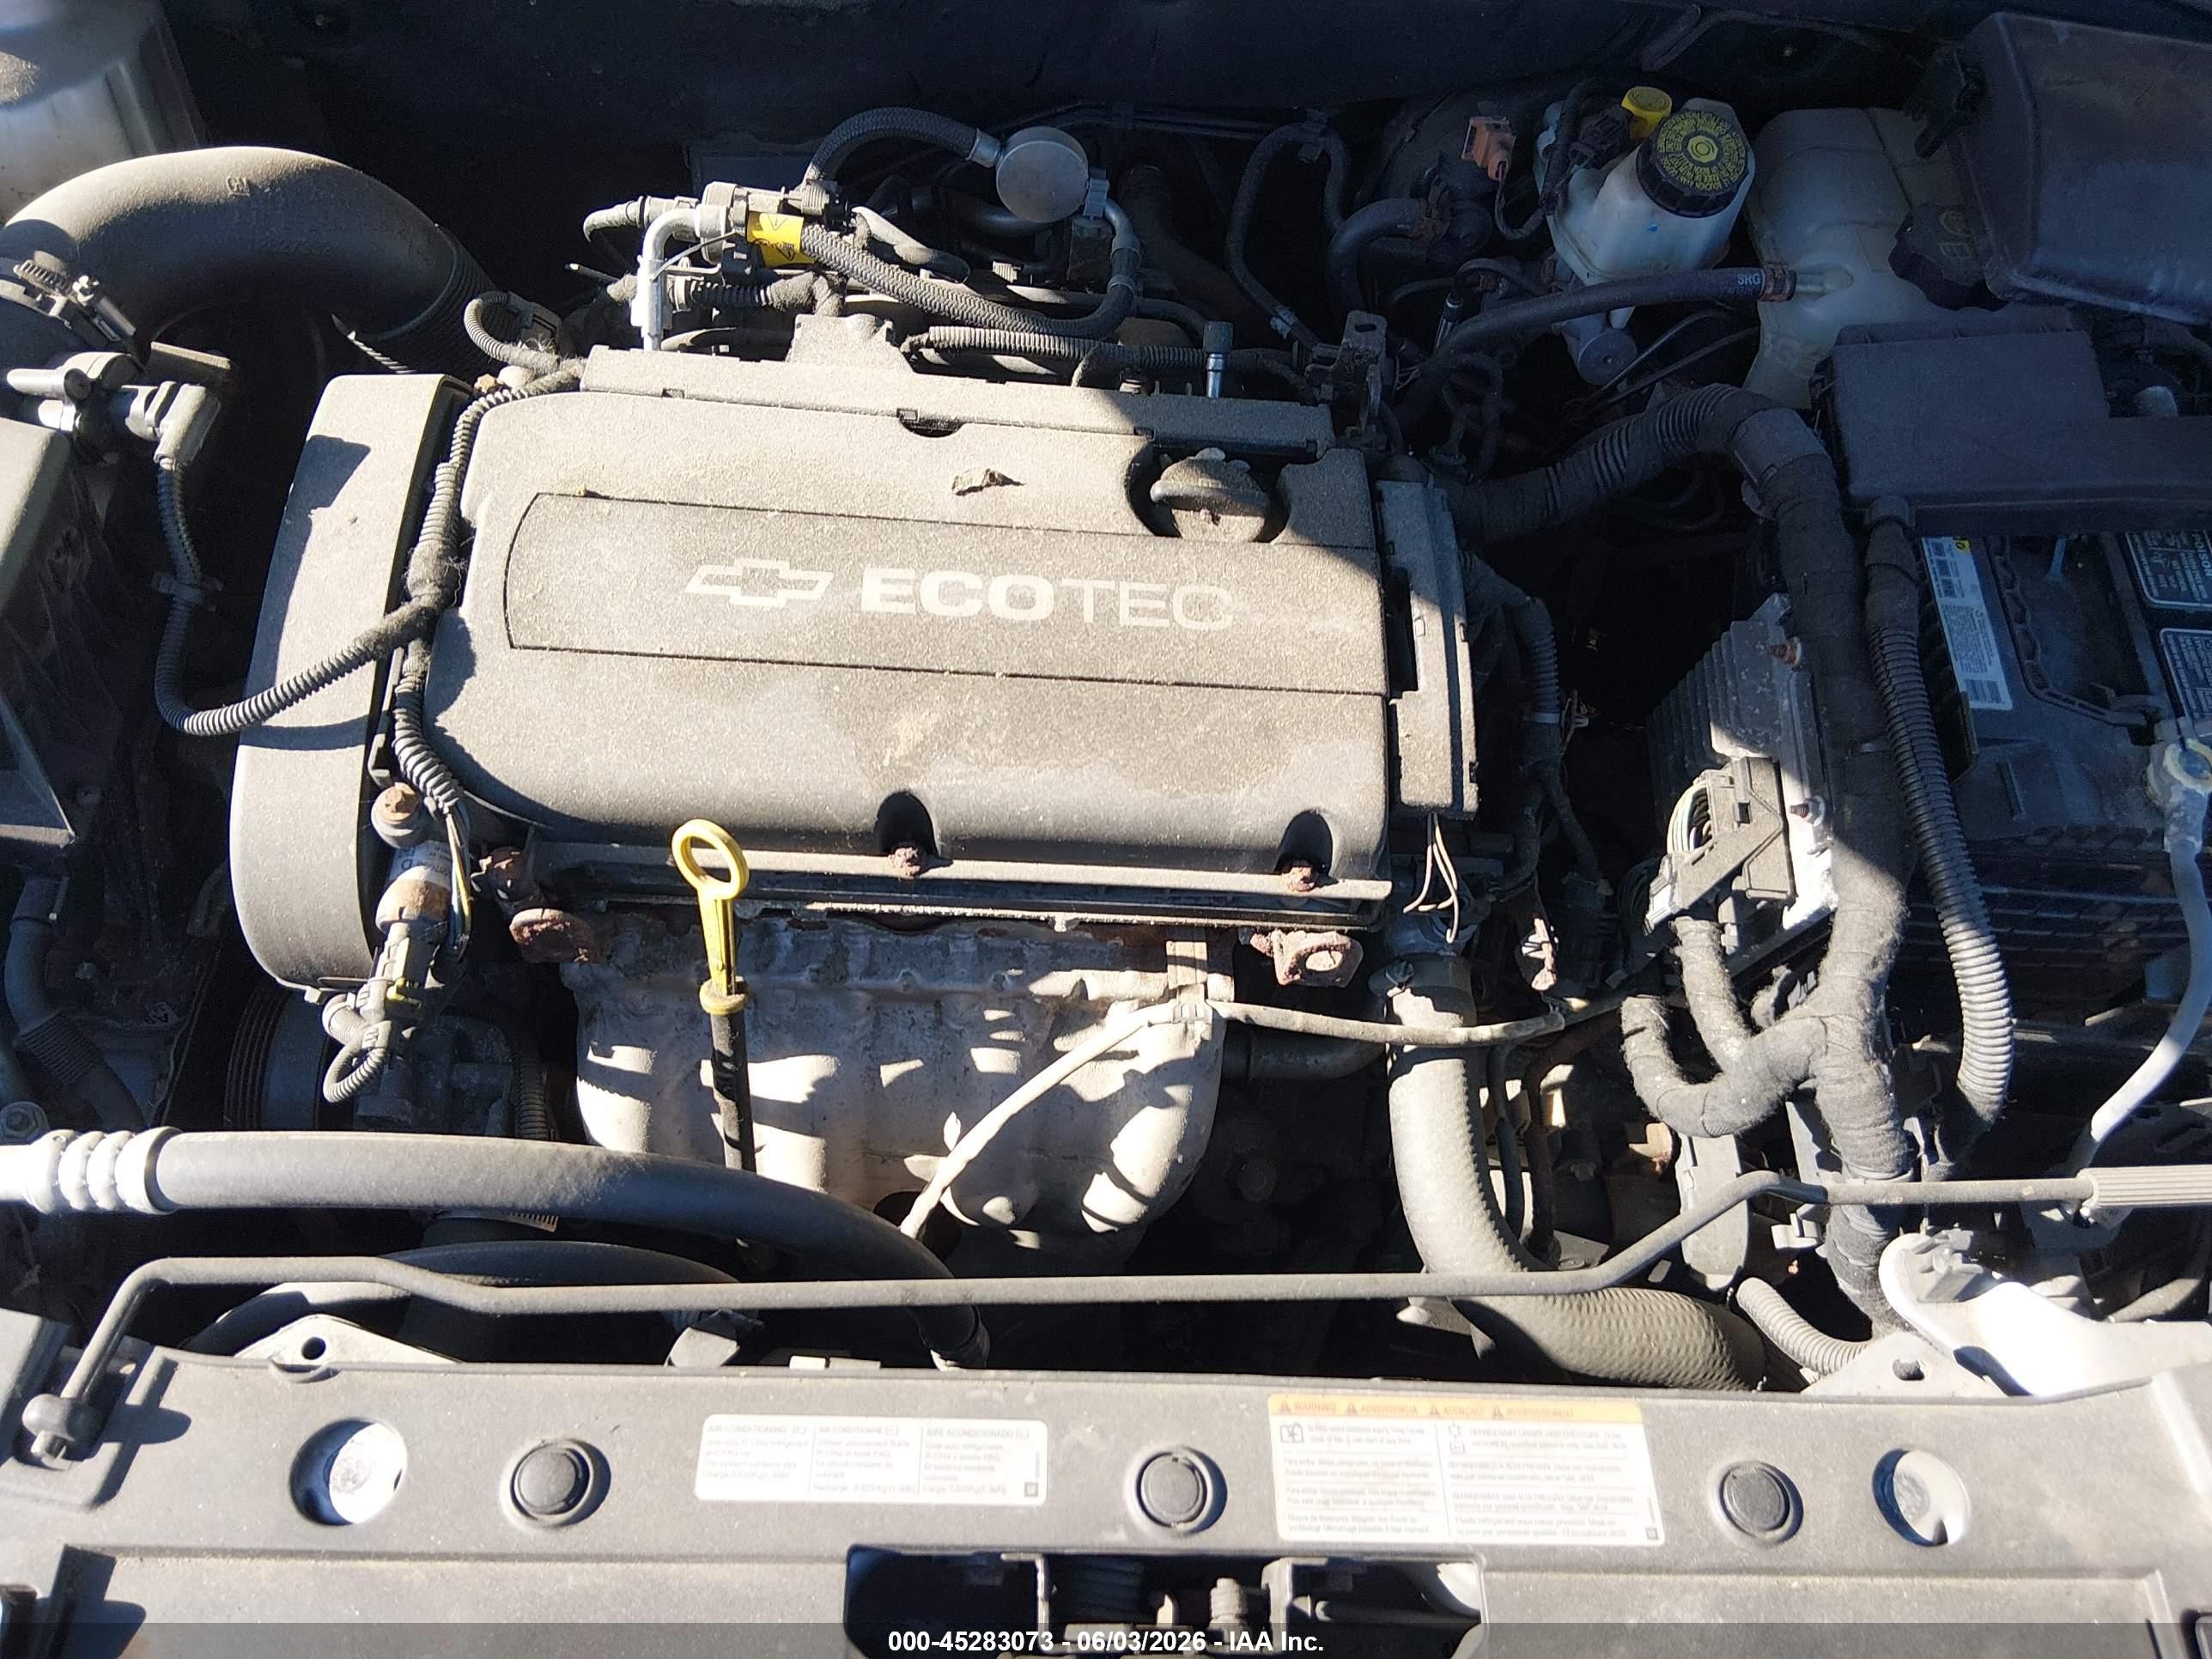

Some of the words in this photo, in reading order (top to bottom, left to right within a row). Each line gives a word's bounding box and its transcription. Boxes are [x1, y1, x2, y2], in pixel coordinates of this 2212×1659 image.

[1737, 274, 1761, 285] SRG
[860, 566, 1236, 631] ECOTEC
[1294, 1401, 1336, 1413] WARNING
[724, 1425, 787, 1435] CONDITIONING
[818, 1425, 832, 1434] AIR
[926, 1427, 944, 1437] AIRE
[946, 1427, 1013, 1437] ACONDICIONADO
